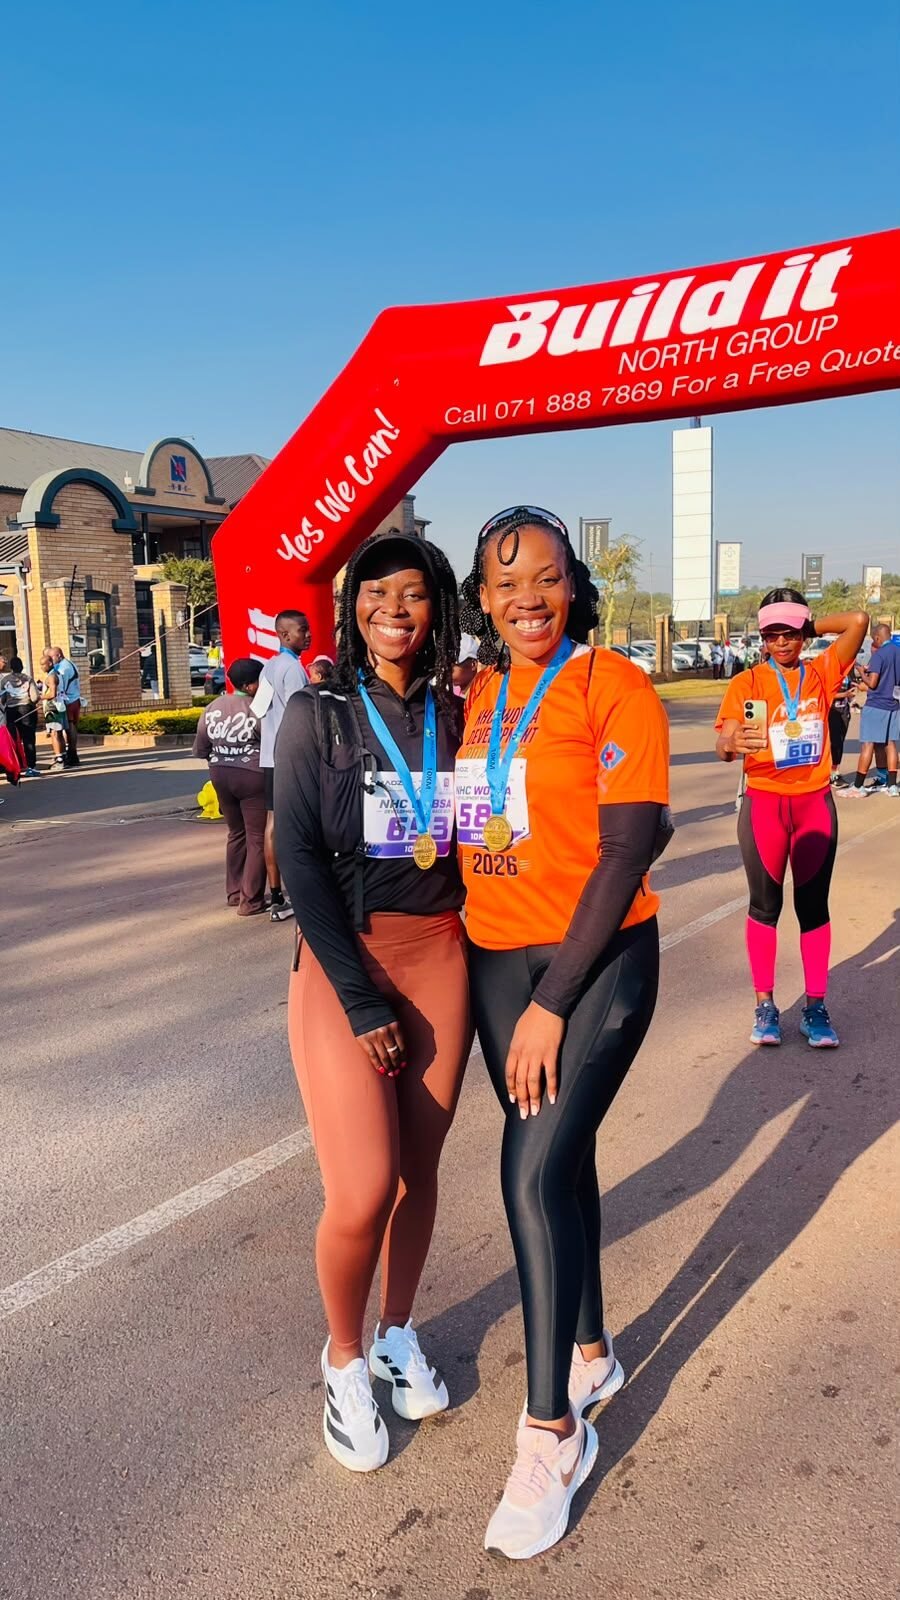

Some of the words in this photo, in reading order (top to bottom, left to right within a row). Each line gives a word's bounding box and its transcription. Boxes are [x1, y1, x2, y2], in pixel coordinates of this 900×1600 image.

[479, 262, 766, 367] Build
[760, 246, 853, 320] it
[618, 338, 718, 375] NORTH
[726, 314, 839, 357] GROUP
[445, 402, 488, 426] Call
[495, 397, 537, 420] 071
[546, 390, 592, 413] 888
[602, 382, 663, 407] 7869
[671, 373, 716, 397] For
[724, 372, 740, 390] a
[748, 356, 811, 385] Free
[276, 516, 325, 563] Yes
[314, 477, 356, 523] We
[344, 407, 400, 486] Can!
[533, 679, 547, 700] 10KM
[501, 706, 541, 724] WOA
[789, 742, 817, 758] 601
[474, 785, 512, 796] WOA
[379, 799, 408, 809] NHC
[411, 799, 452, 809] BSA
[459, 803, 507, 828] 58
[470, 832, 484, 841] 10K
[404, 845, 414, 853] 10
[473, 852, 518, 877] 2026
